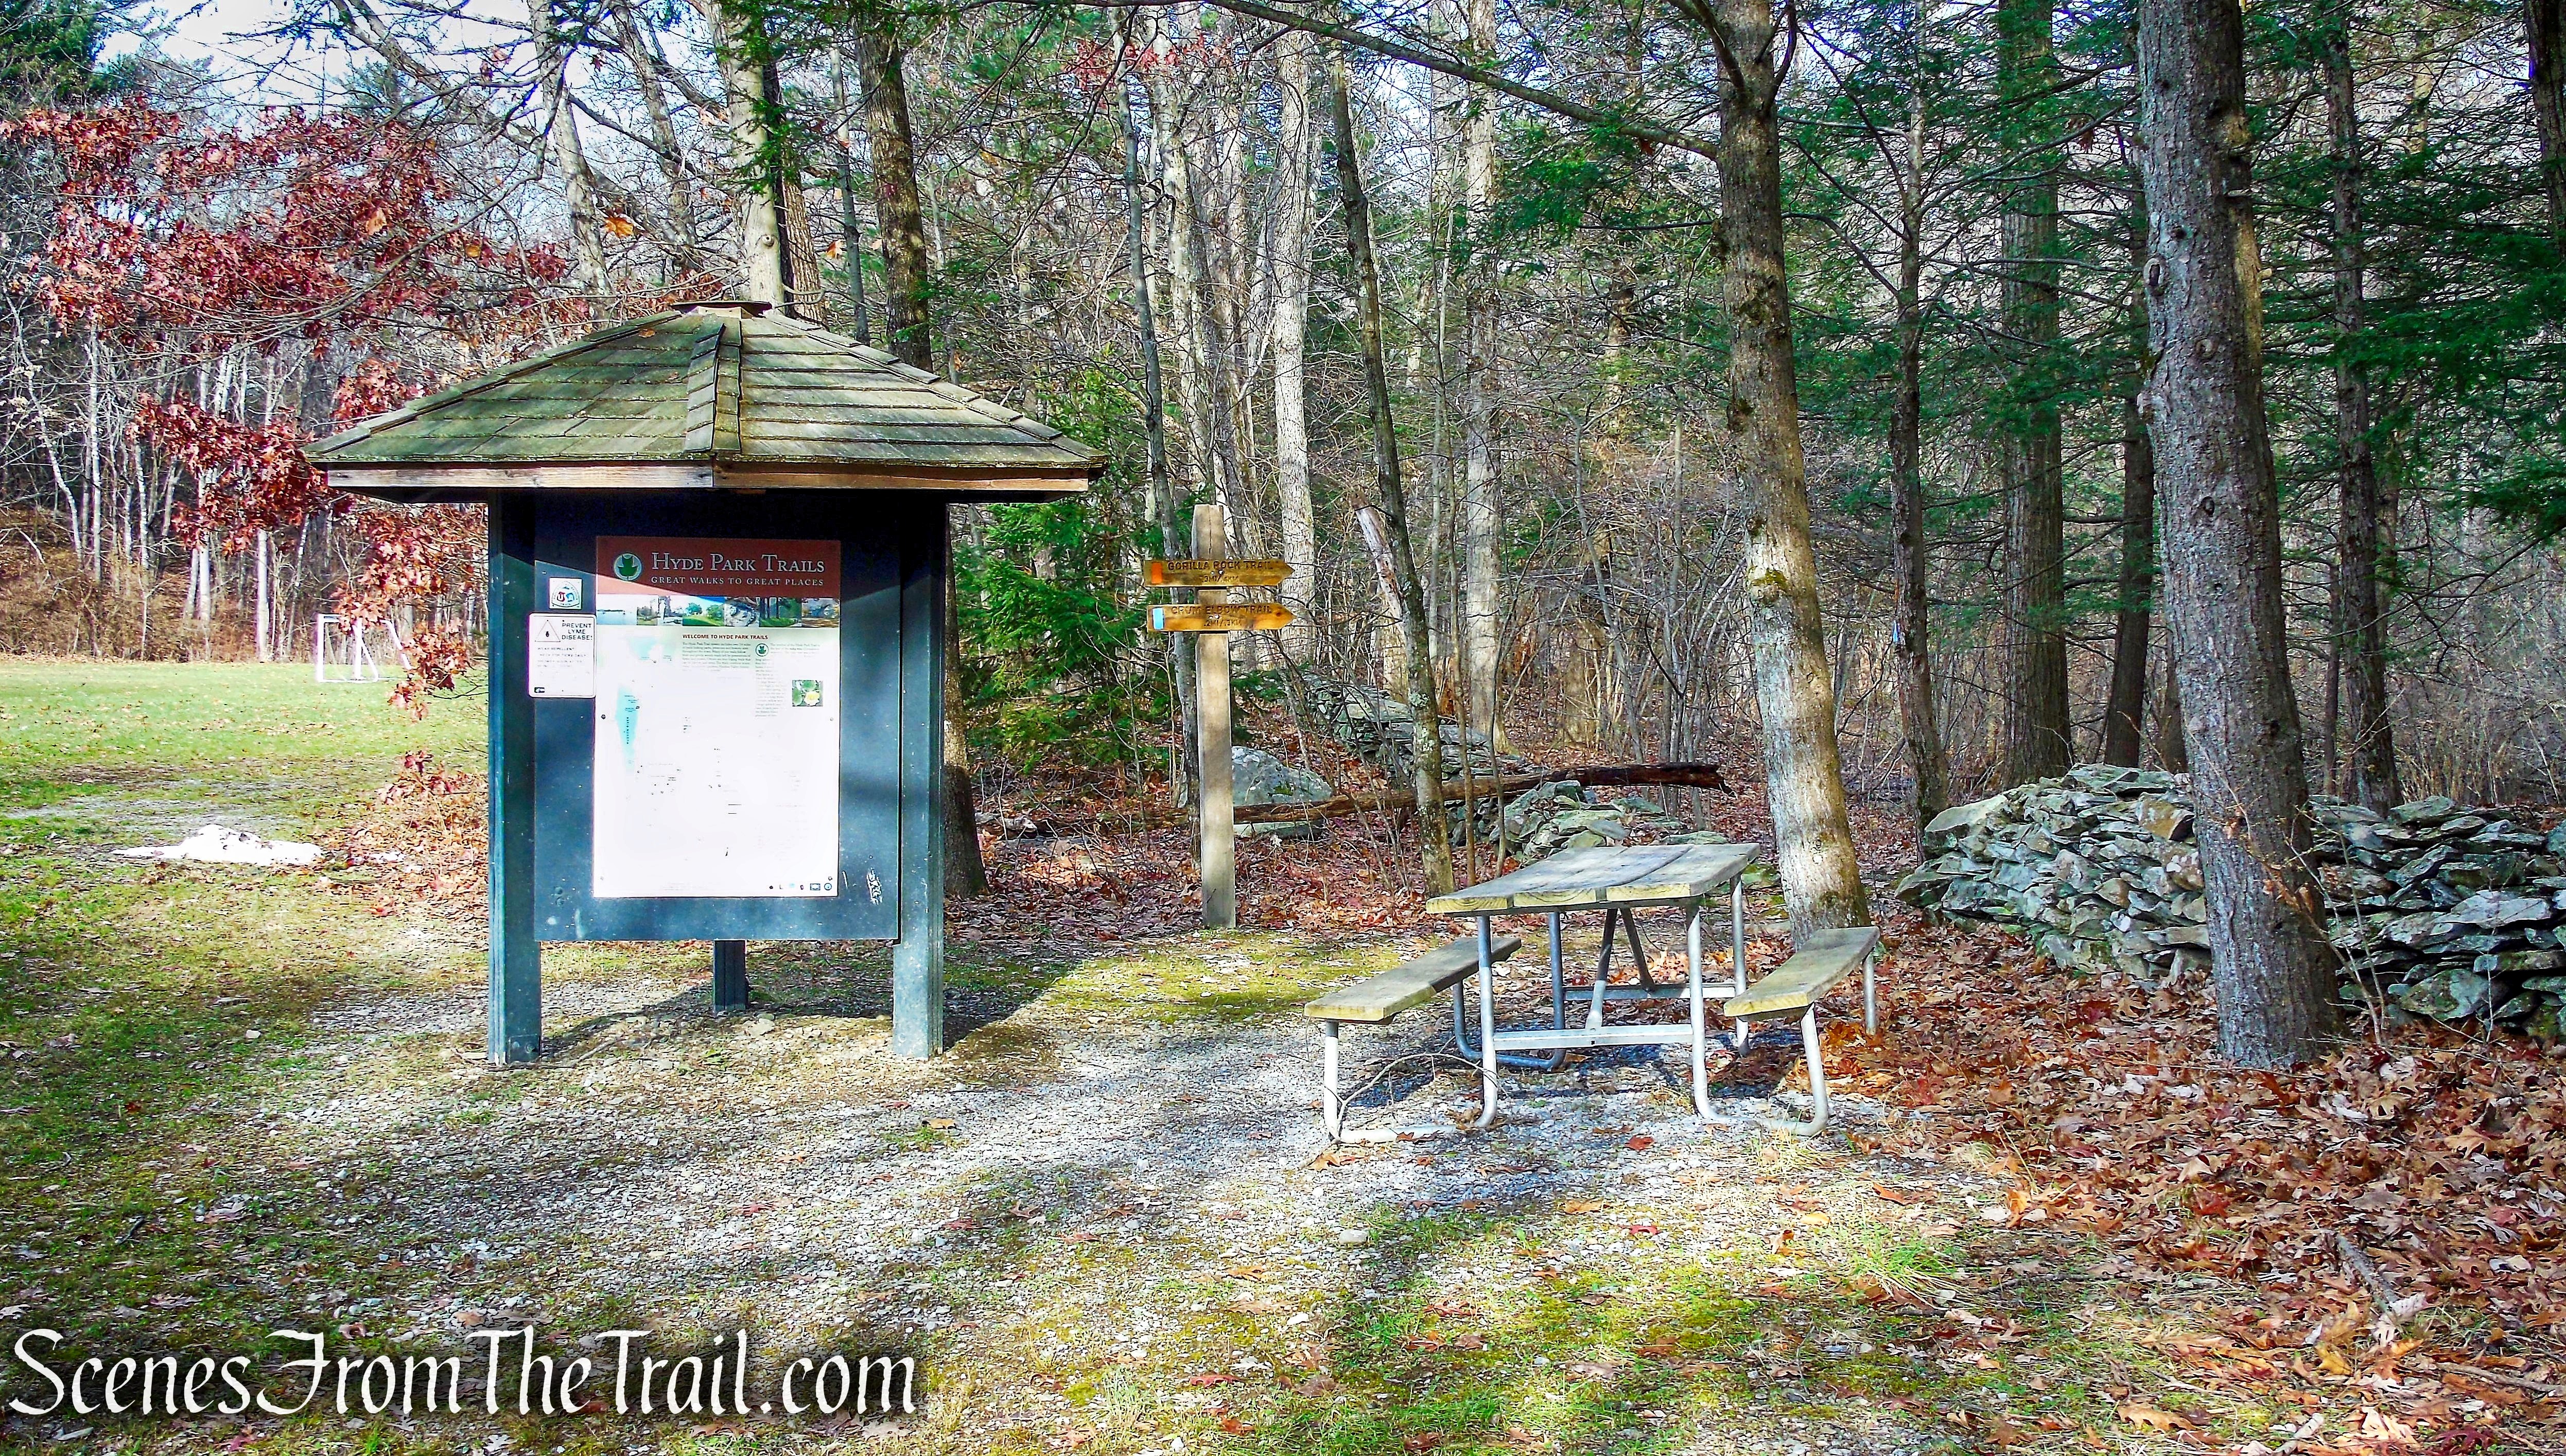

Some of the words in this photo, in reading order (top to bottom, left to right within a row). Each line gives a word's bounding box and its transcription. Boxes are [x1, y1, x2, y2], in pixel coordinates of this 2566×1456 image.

[652, 553, 704, 570] HYDE
[710, 554, 756, 571] PARK
[762, 554, 825, 573] TRAILS
[1168, 560, 1209, 570] GORILLA
[1213, 560, 1240, 569] ROCK
[1243, 560, 1273, 569] TRAIL
[1172, 606, 1200, 615] CRUM
[1206, 606, 1241, 614] ELBOW
[1242, 605, 1272, 613] TRAIL
